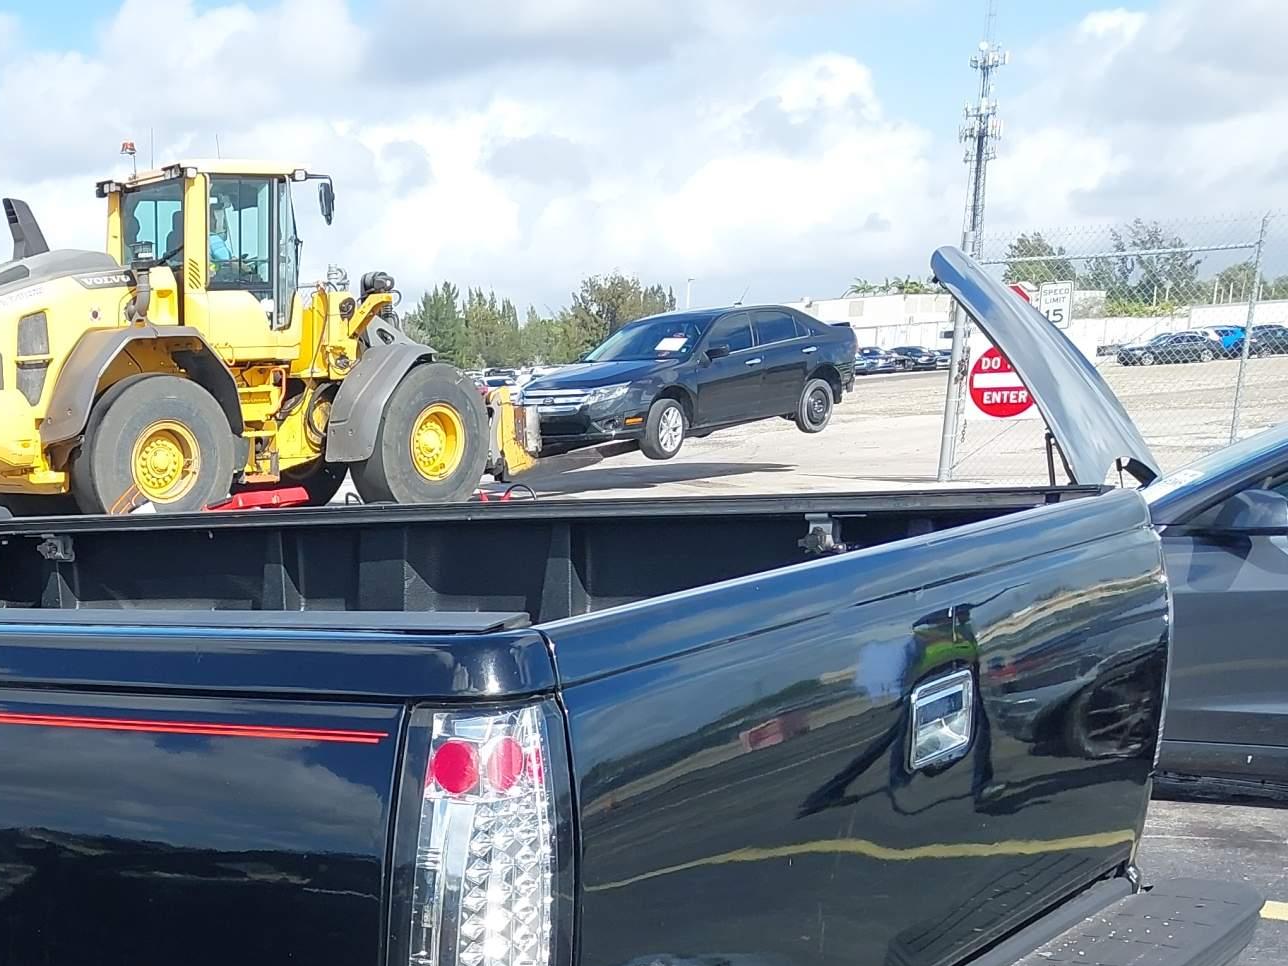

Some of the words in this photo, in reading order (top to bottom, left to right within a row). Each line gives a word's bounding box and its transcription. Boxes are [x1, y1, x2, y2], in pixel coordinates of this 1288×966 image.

[80, 274, 131, 285] VOLVO
[1043, 287, 1069, 297] SPEED
[1045, 296, 1067, 305] LIMIT
[1044, 308, 1064, 323] 15
[981, 356, 1002, 370] DO
[982, 390, 1028, 405] ENTER
